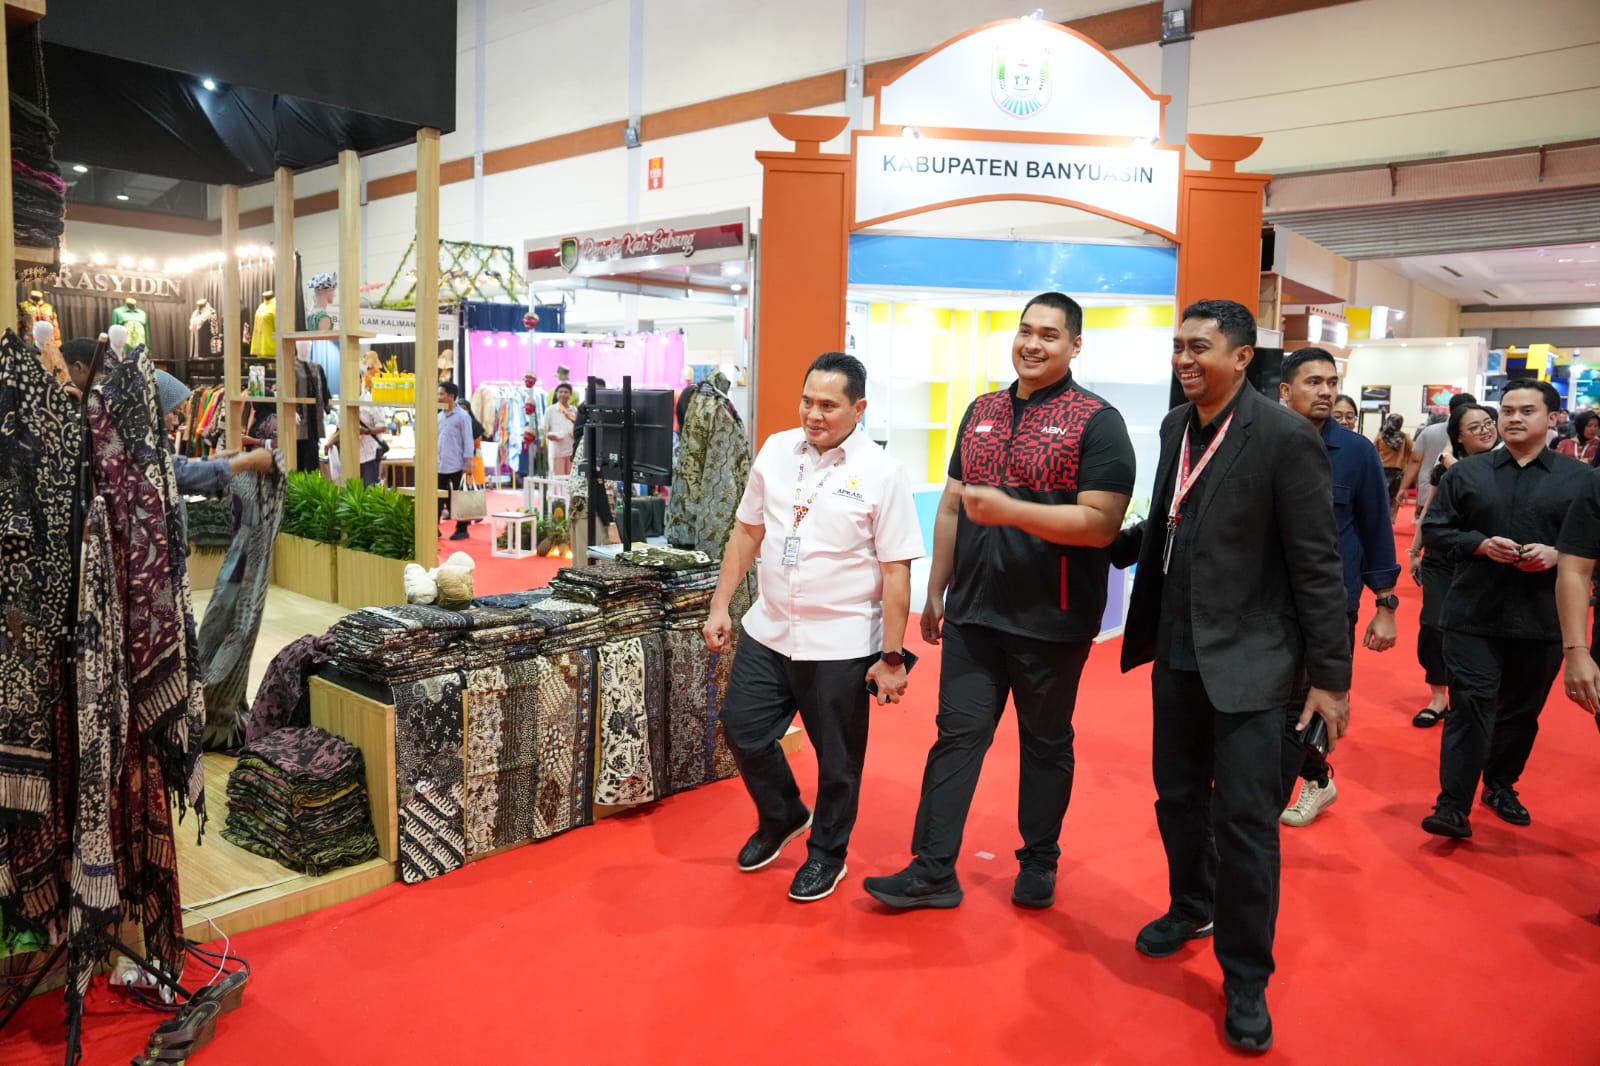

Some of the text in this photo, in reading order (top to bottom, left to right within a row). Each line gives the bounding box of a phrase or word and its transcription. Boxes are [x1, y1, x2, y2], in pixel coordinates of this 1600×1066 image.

[882, 154, 1154, 184] KABUPATEN BANYUASIN
[651, 228, 695, 258] Subang
